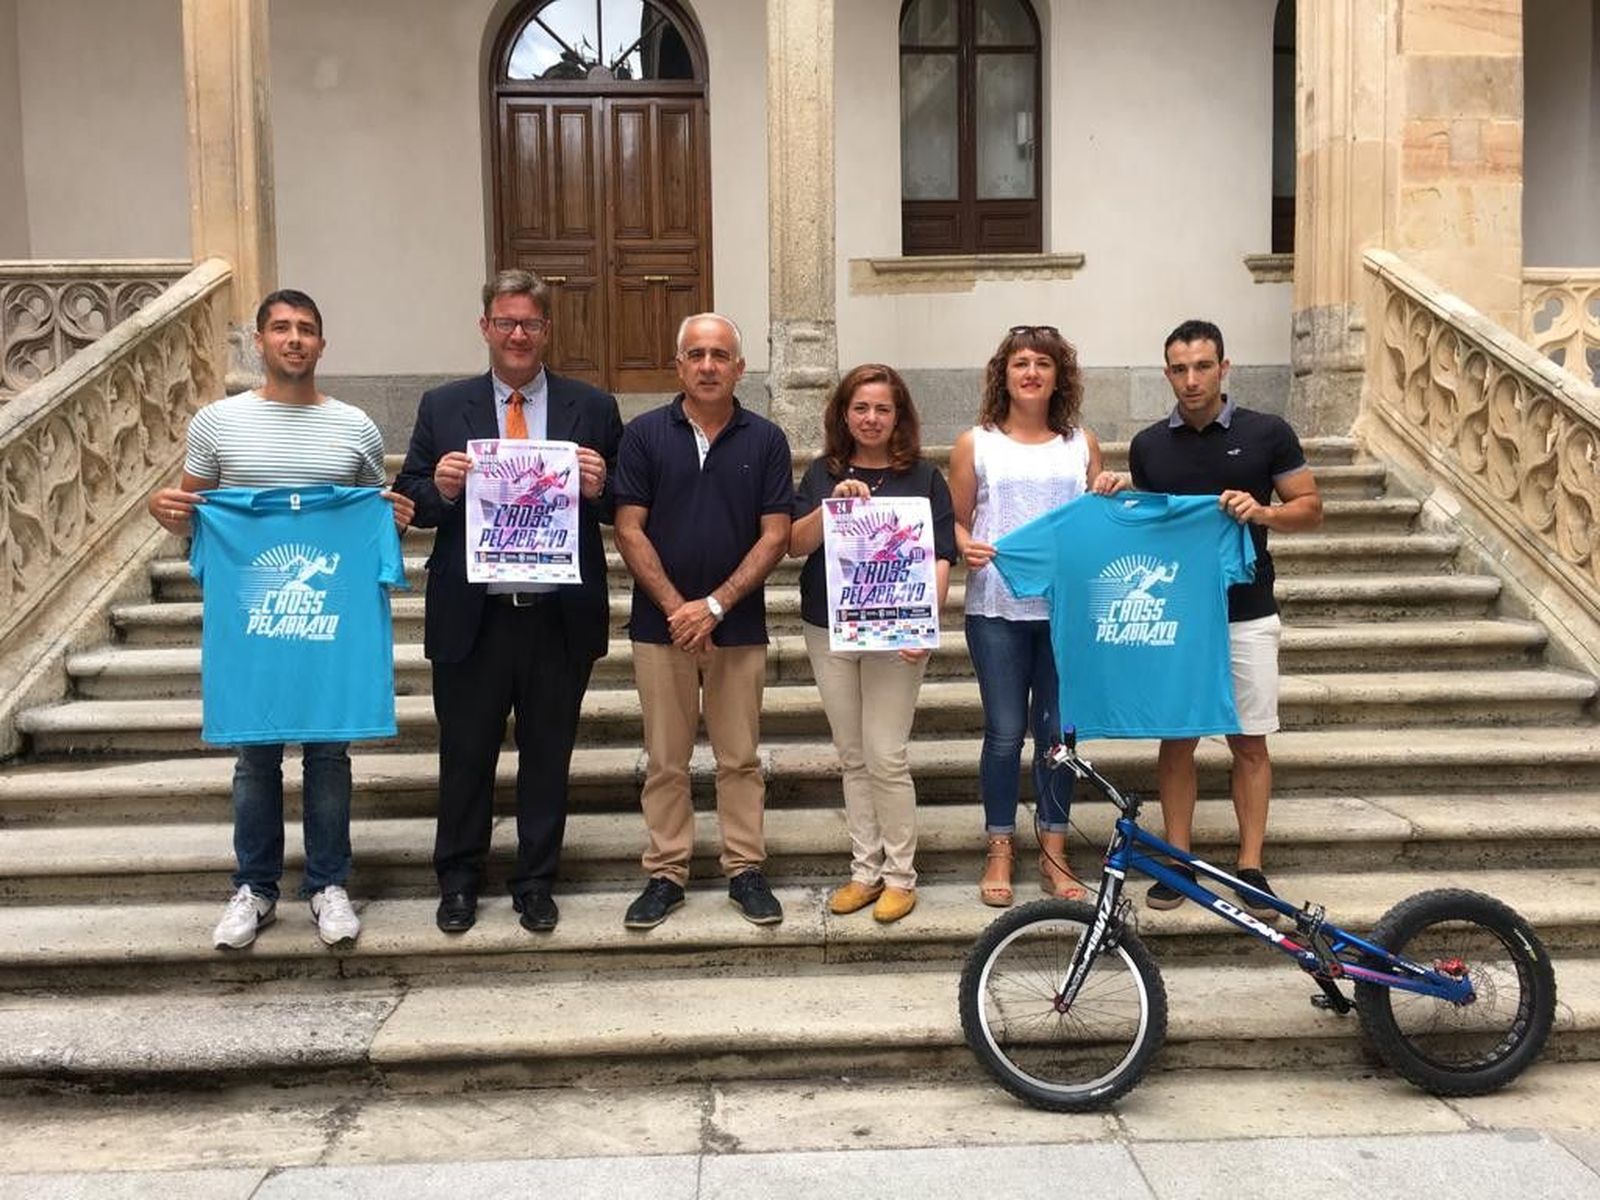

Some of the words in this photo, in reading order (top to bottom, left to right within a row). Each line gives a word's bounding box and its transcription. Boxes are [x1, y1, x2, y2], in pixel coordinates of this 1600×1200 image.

[494, 503, 556, 528] CROSS
[852, 559, 913, 585] CROSS
[262, 590, 327, 614] CROSS
[1108, 598, 1166, 622] CROSS
